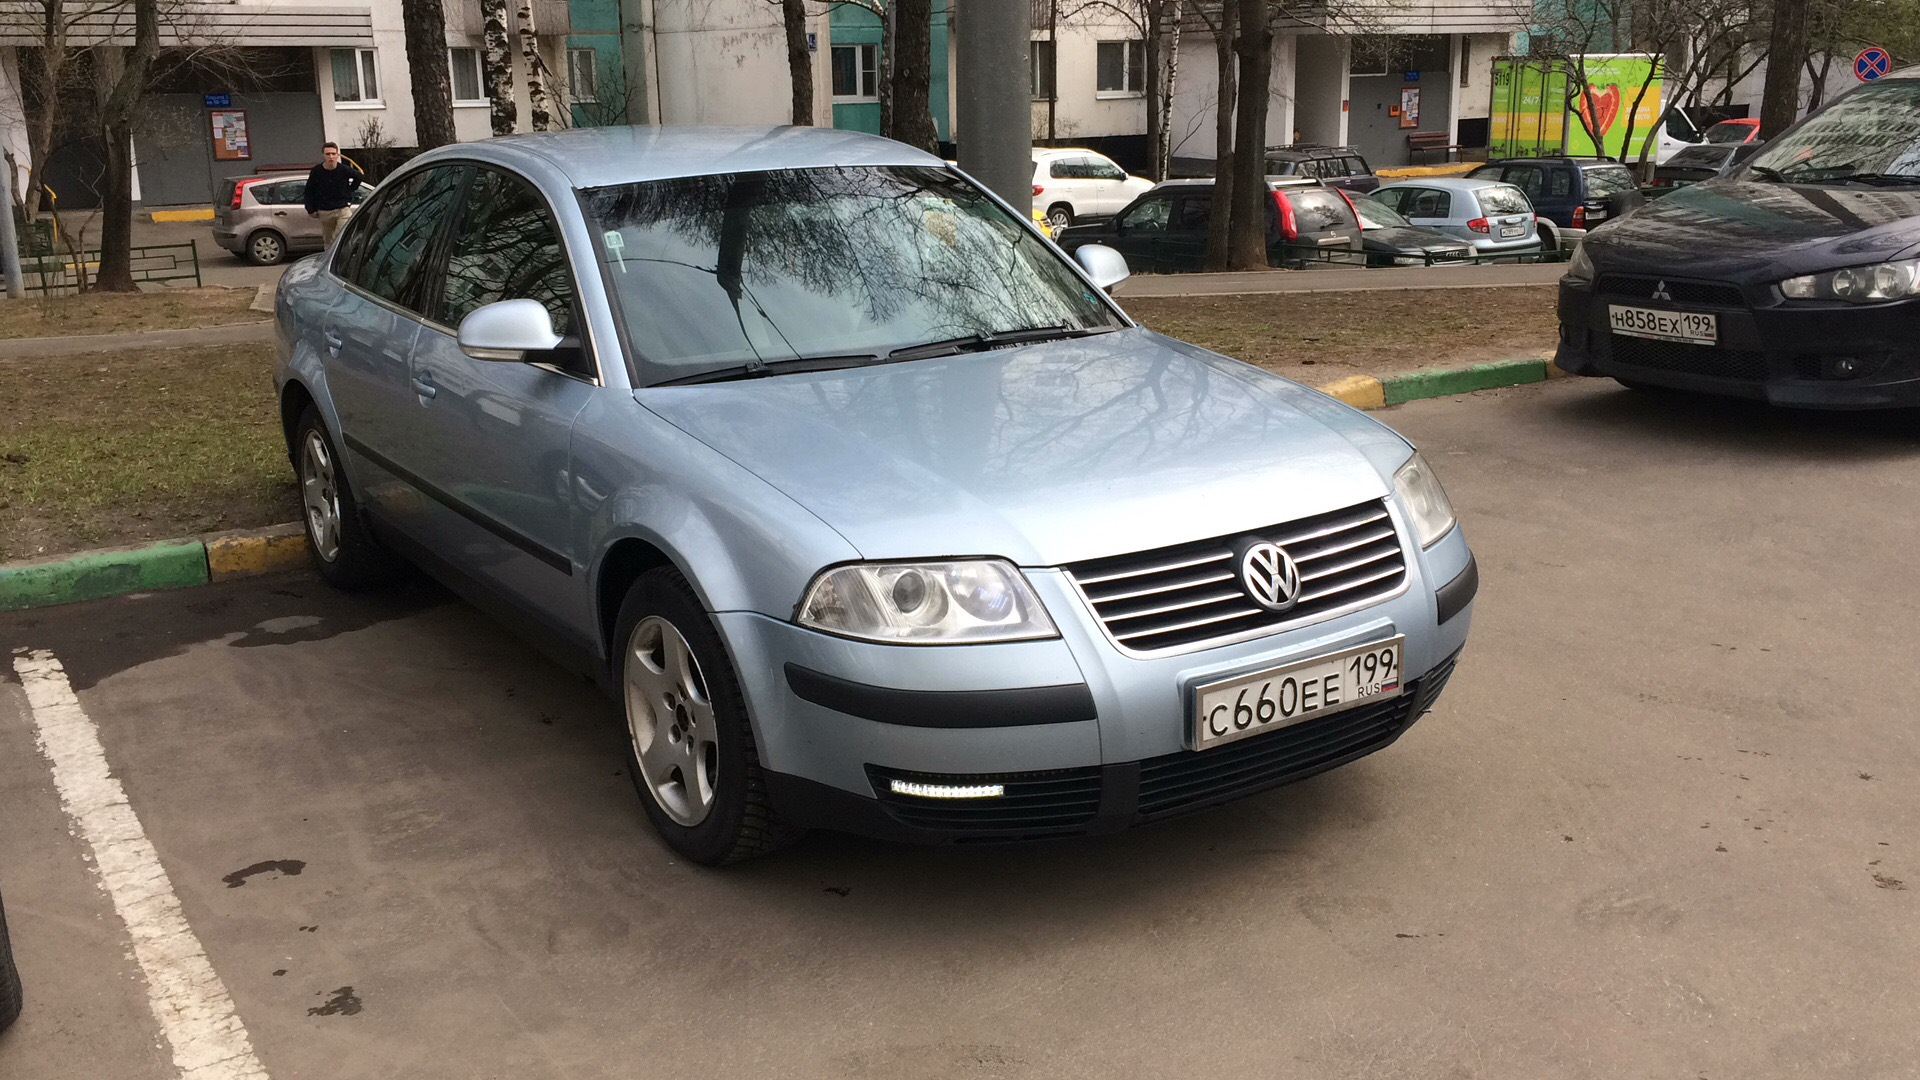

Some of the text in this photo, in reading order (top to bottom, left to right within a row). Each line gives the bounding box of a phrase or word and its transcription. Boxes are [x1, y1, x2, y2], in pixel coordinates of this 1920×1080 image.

[1522, 96, 1539, 105] 24/7
[1683, 314, 1711, 331] 199
[1209, 648, 1394, 737] С660ЕЕ 199
[1357, 682, 1380, 699] RUS
